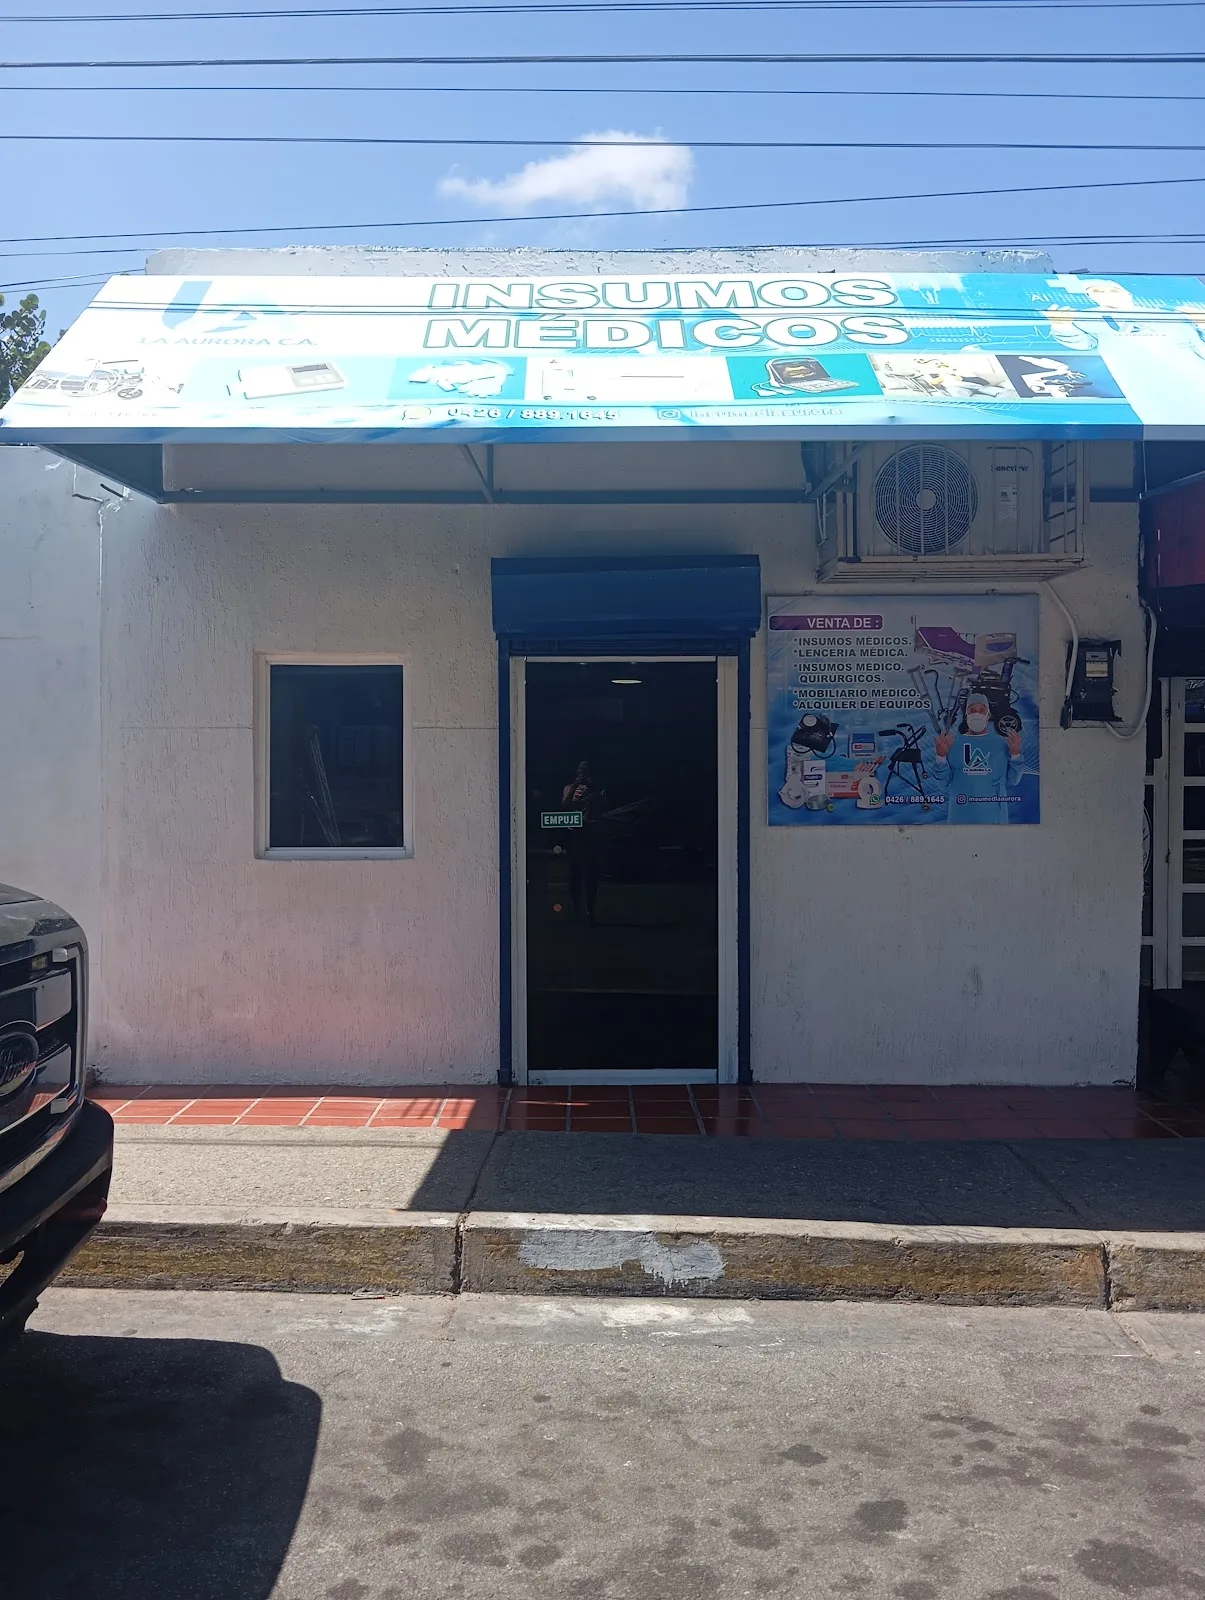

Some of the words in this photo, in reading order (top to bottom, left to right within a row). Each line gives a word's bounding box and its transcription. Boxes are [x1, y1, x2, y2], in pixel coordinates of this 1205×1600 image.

[427, 278, 897, 310] INSUMOS
[423, 313, 909, 349] MÉDICOS
[139, 337, 168, 345] LA
[174, 337, 271, 345] AURORA
[447, 408, 502, 420] 0426
[519, 408, 620, 421] 889.1645
[807, 617, 851, 629] VENTA
[853, 618, 872, 629] DE
[798, 637, 852, 646] INSUMOS
[855, 634, 911, 646] MÉDICOS.
[798, 648, 857, 658] LENCERIA
[860, 646, 908, 657] MÉDICA.
[798, 663, 852, 672] INSUMOS
[855, 661, 904, 671] MÉDICO.
[799, 673, 884, 684] QUIRÚRGICOS.
[798, 689, 868, 698] MOBILIARIO
[871, 687, 920, 698] MÉDICO.
[798, 700, 857, 710] ALQUILER
[860, 700, 875, 709] DE
[879, 700, 931, 710] EQUIPOS
[885, 795, 904, 803] 0426
[910, 795, 945, 803] 889.1645
[544, 815, 580, 825] EMPUJE
